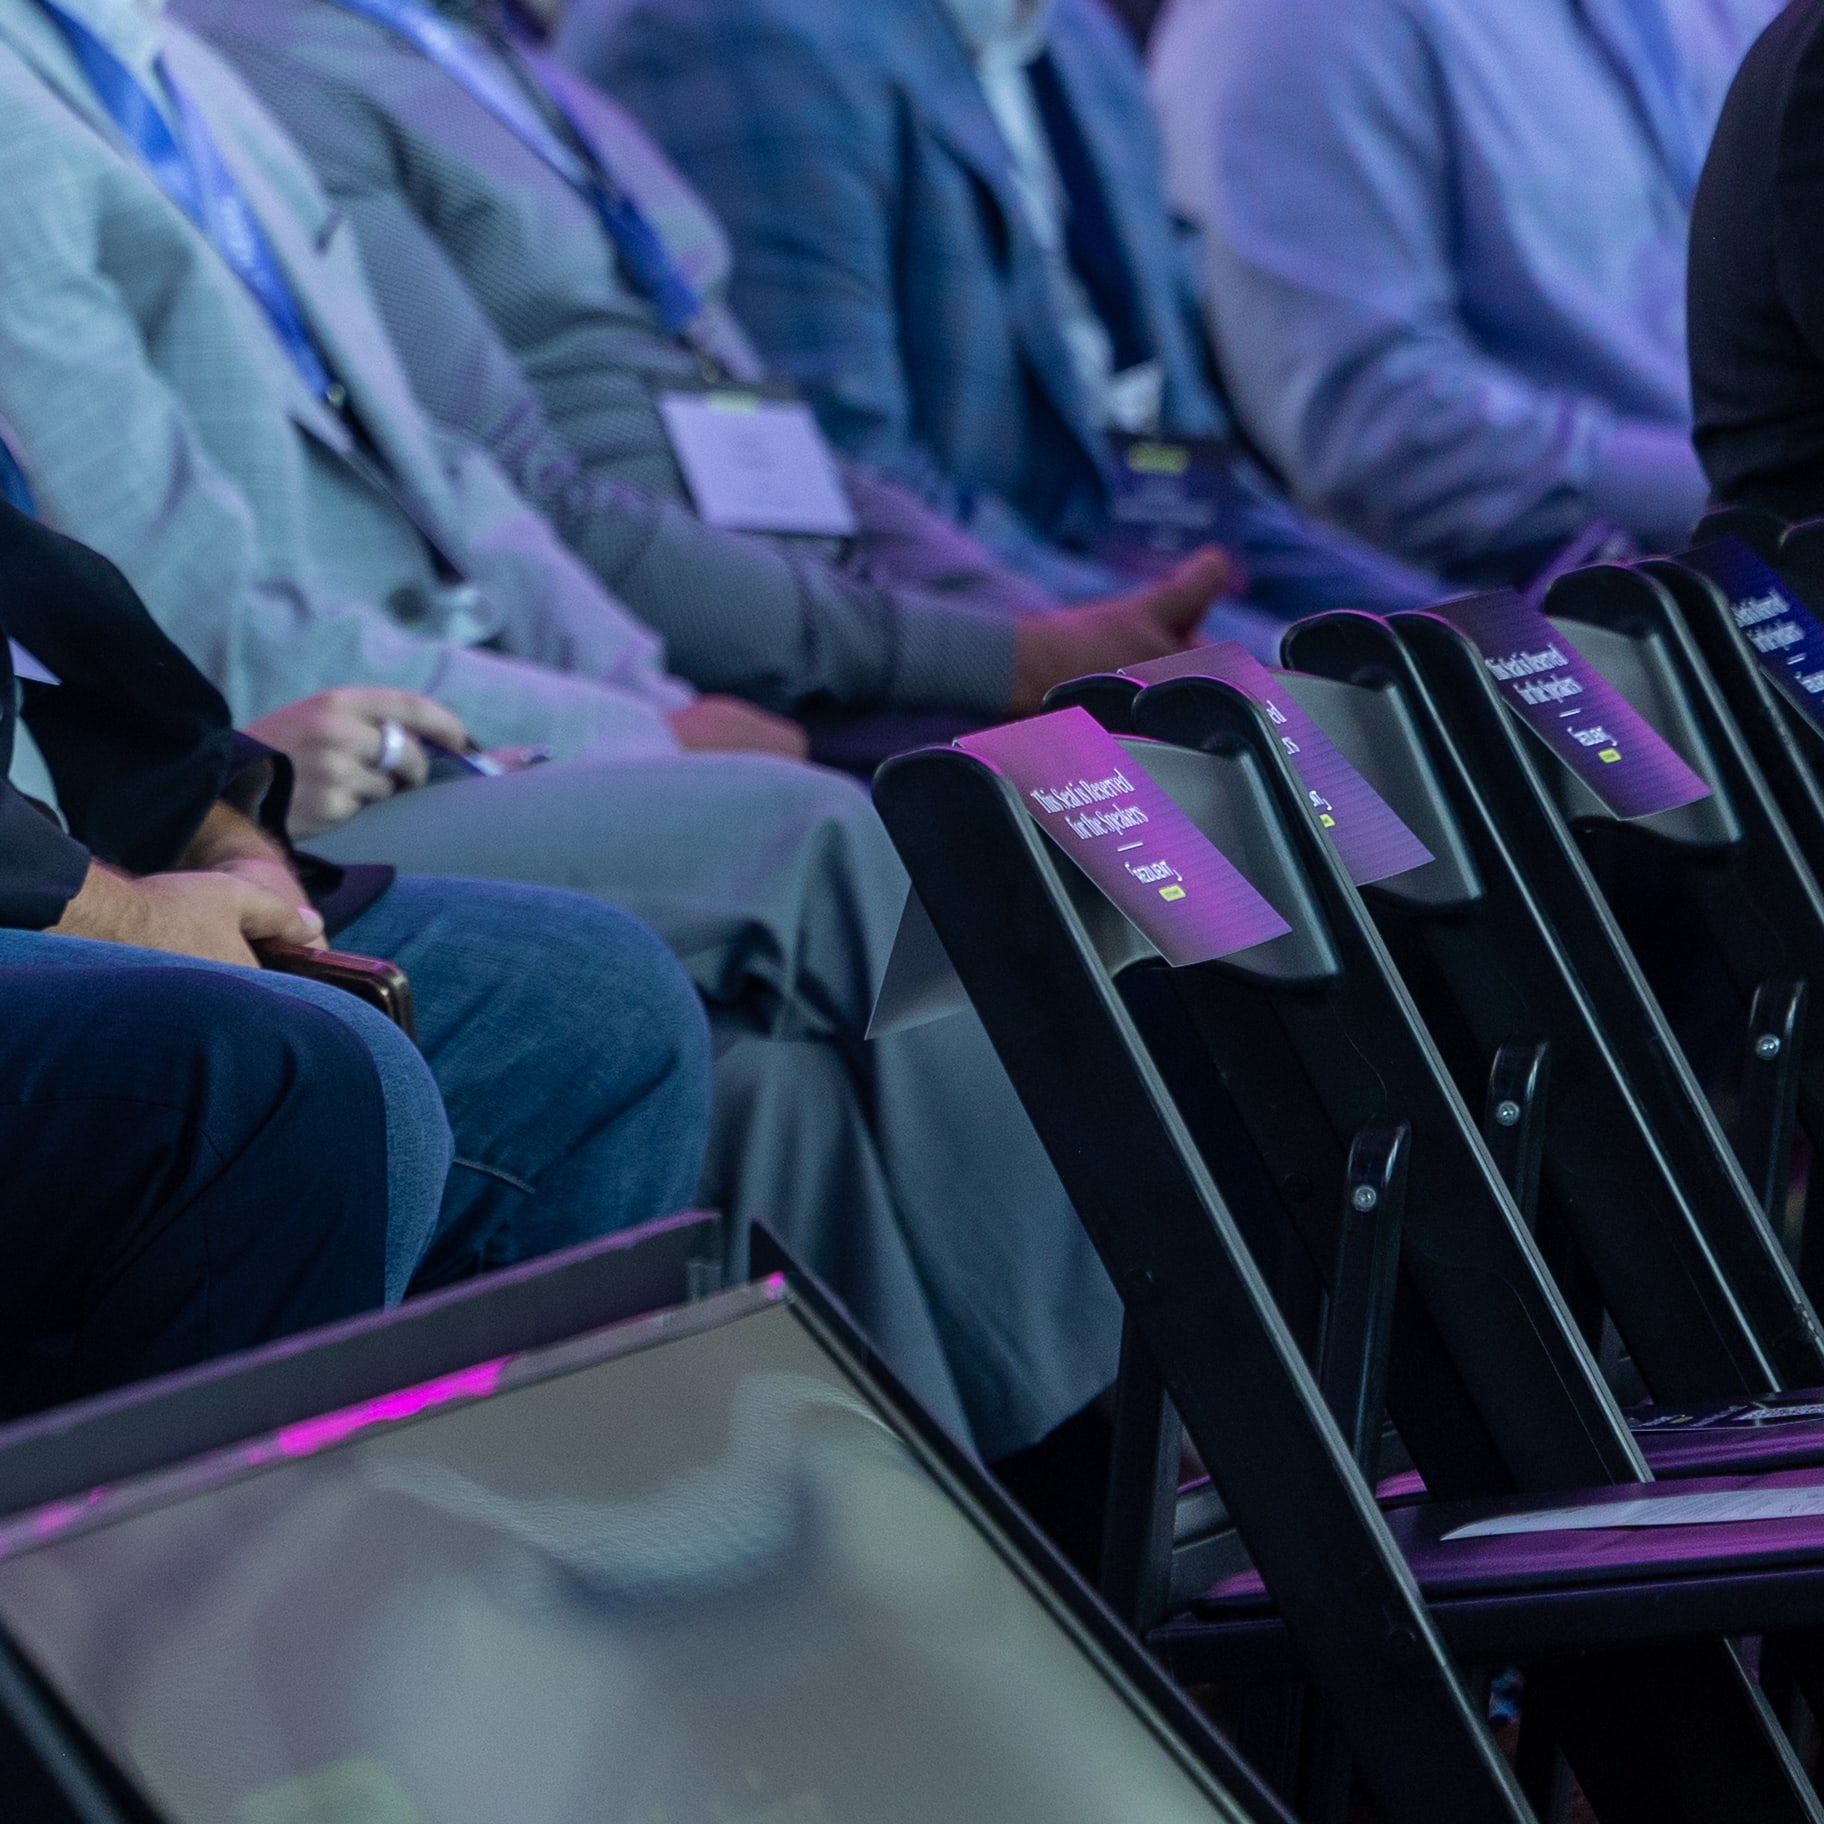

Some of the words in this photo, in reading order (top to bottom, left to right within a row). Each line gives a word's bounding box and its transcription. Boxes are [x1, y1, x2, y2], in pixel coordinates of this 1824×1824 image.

[1030, 789, 1064, 813] This
[1050, 785, 1084, 809] Seat
[1079, 768, 1135, 802] Reserved
[1065, 816, 1092, 839] for
[1080, 813, 1108, 836] the
[1095, 804, 1149, 835] Speakers
[1126, 860, 1182, 884] REZILIENT
